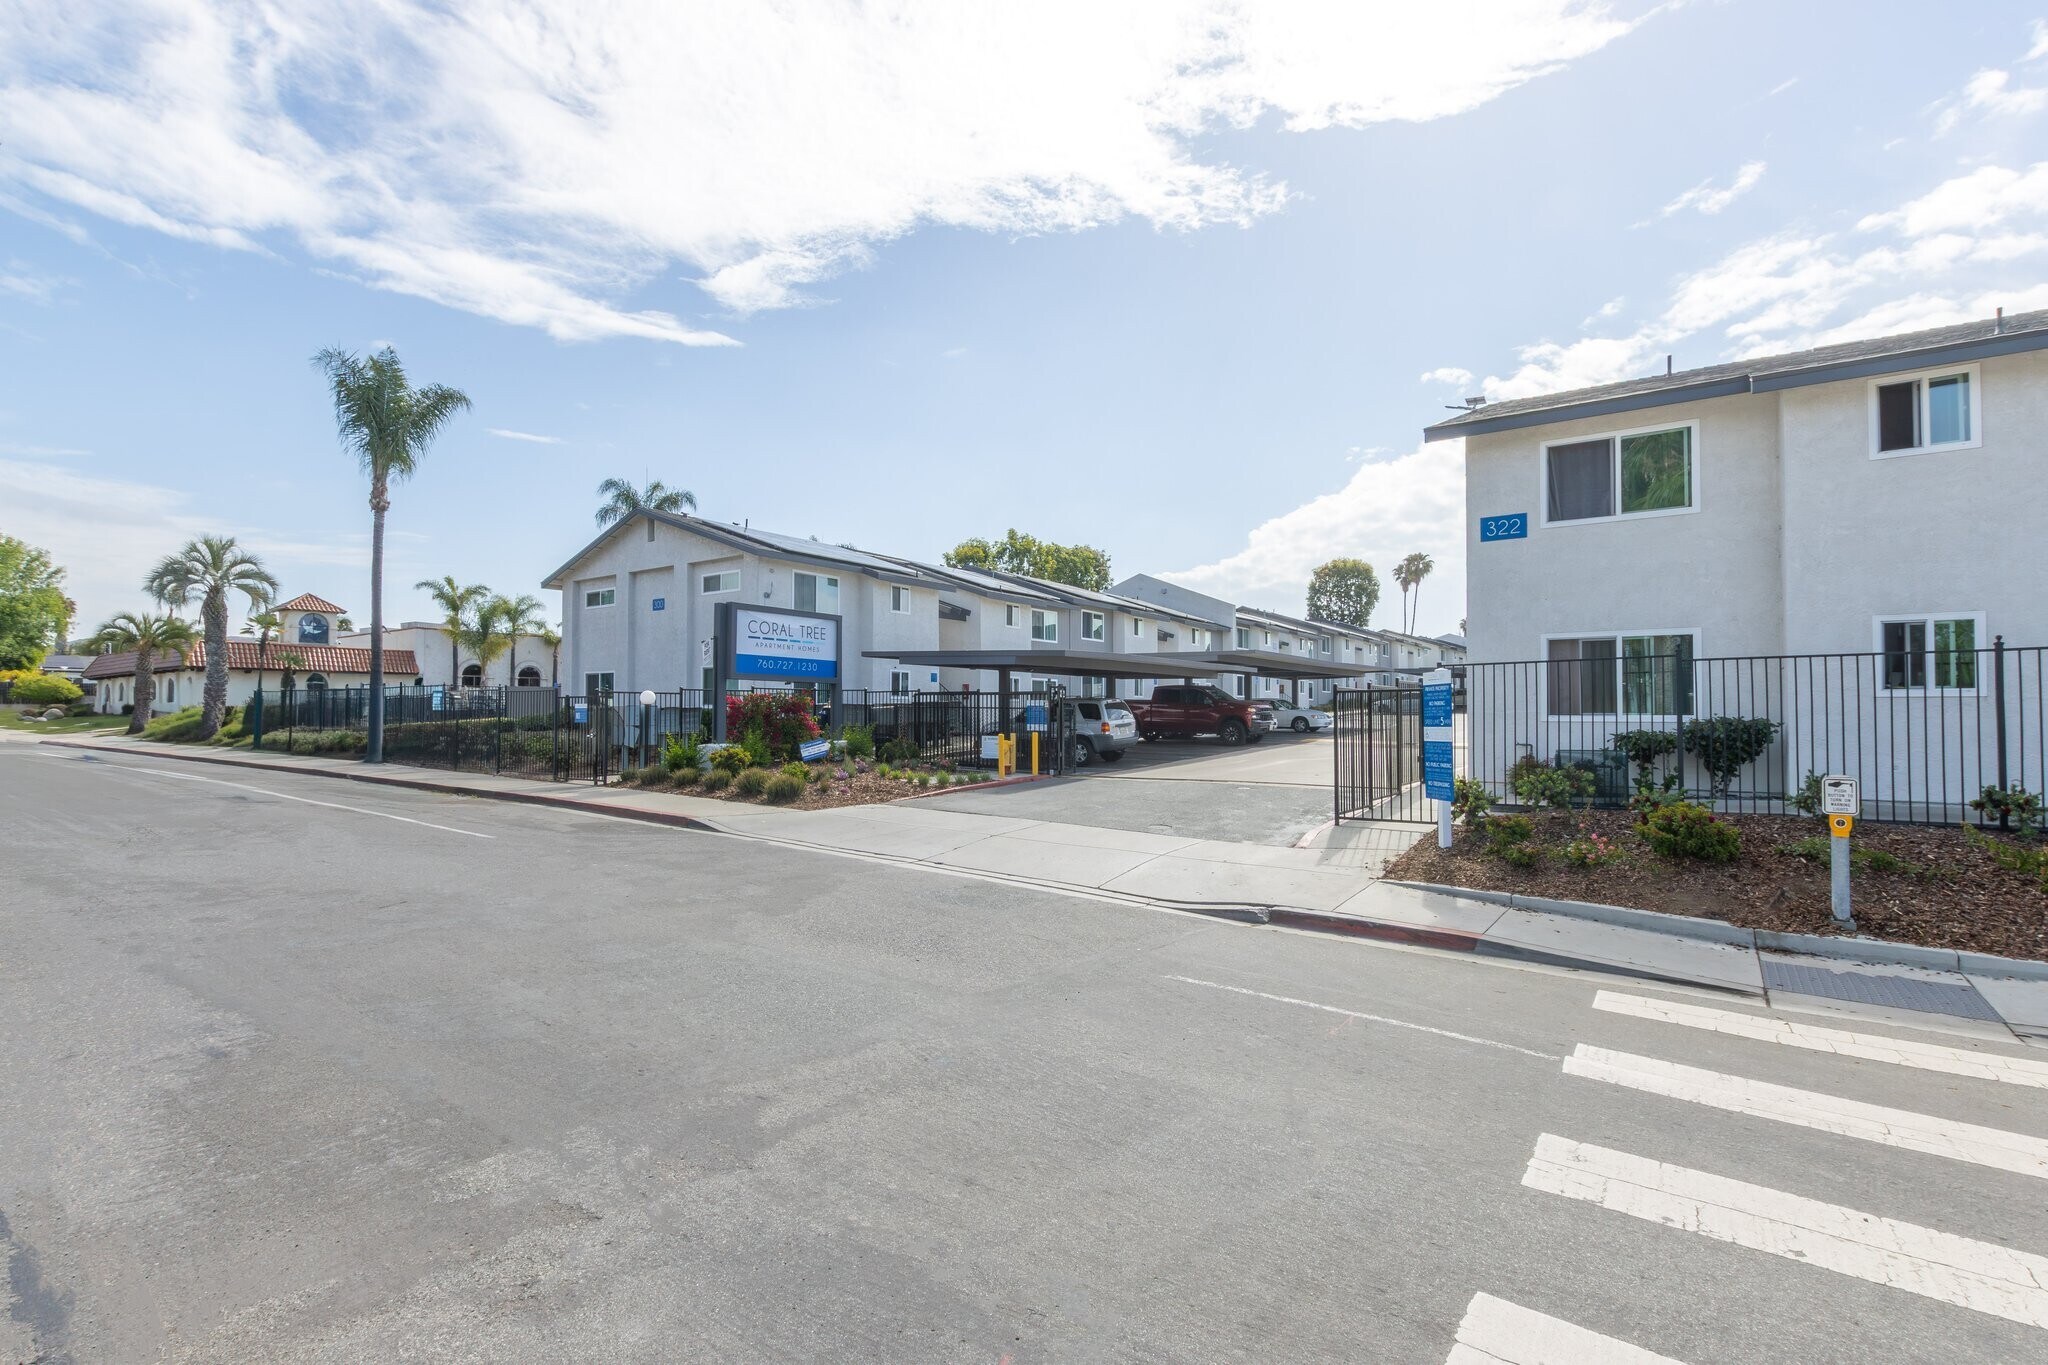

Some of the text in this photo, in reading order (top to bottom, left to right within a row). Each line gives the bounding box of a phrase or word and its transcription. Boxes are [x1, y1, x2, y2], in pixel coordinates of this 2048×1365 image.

[1486, 518, 1521, 537] 322
[748, 619, 827, 640] CORAL TREE
[754, 642, 820, 653] APARTMENT HOMES
[757, 659, 818, 672] 760.727.1230
[1440, 716, 1445, 726] 5
